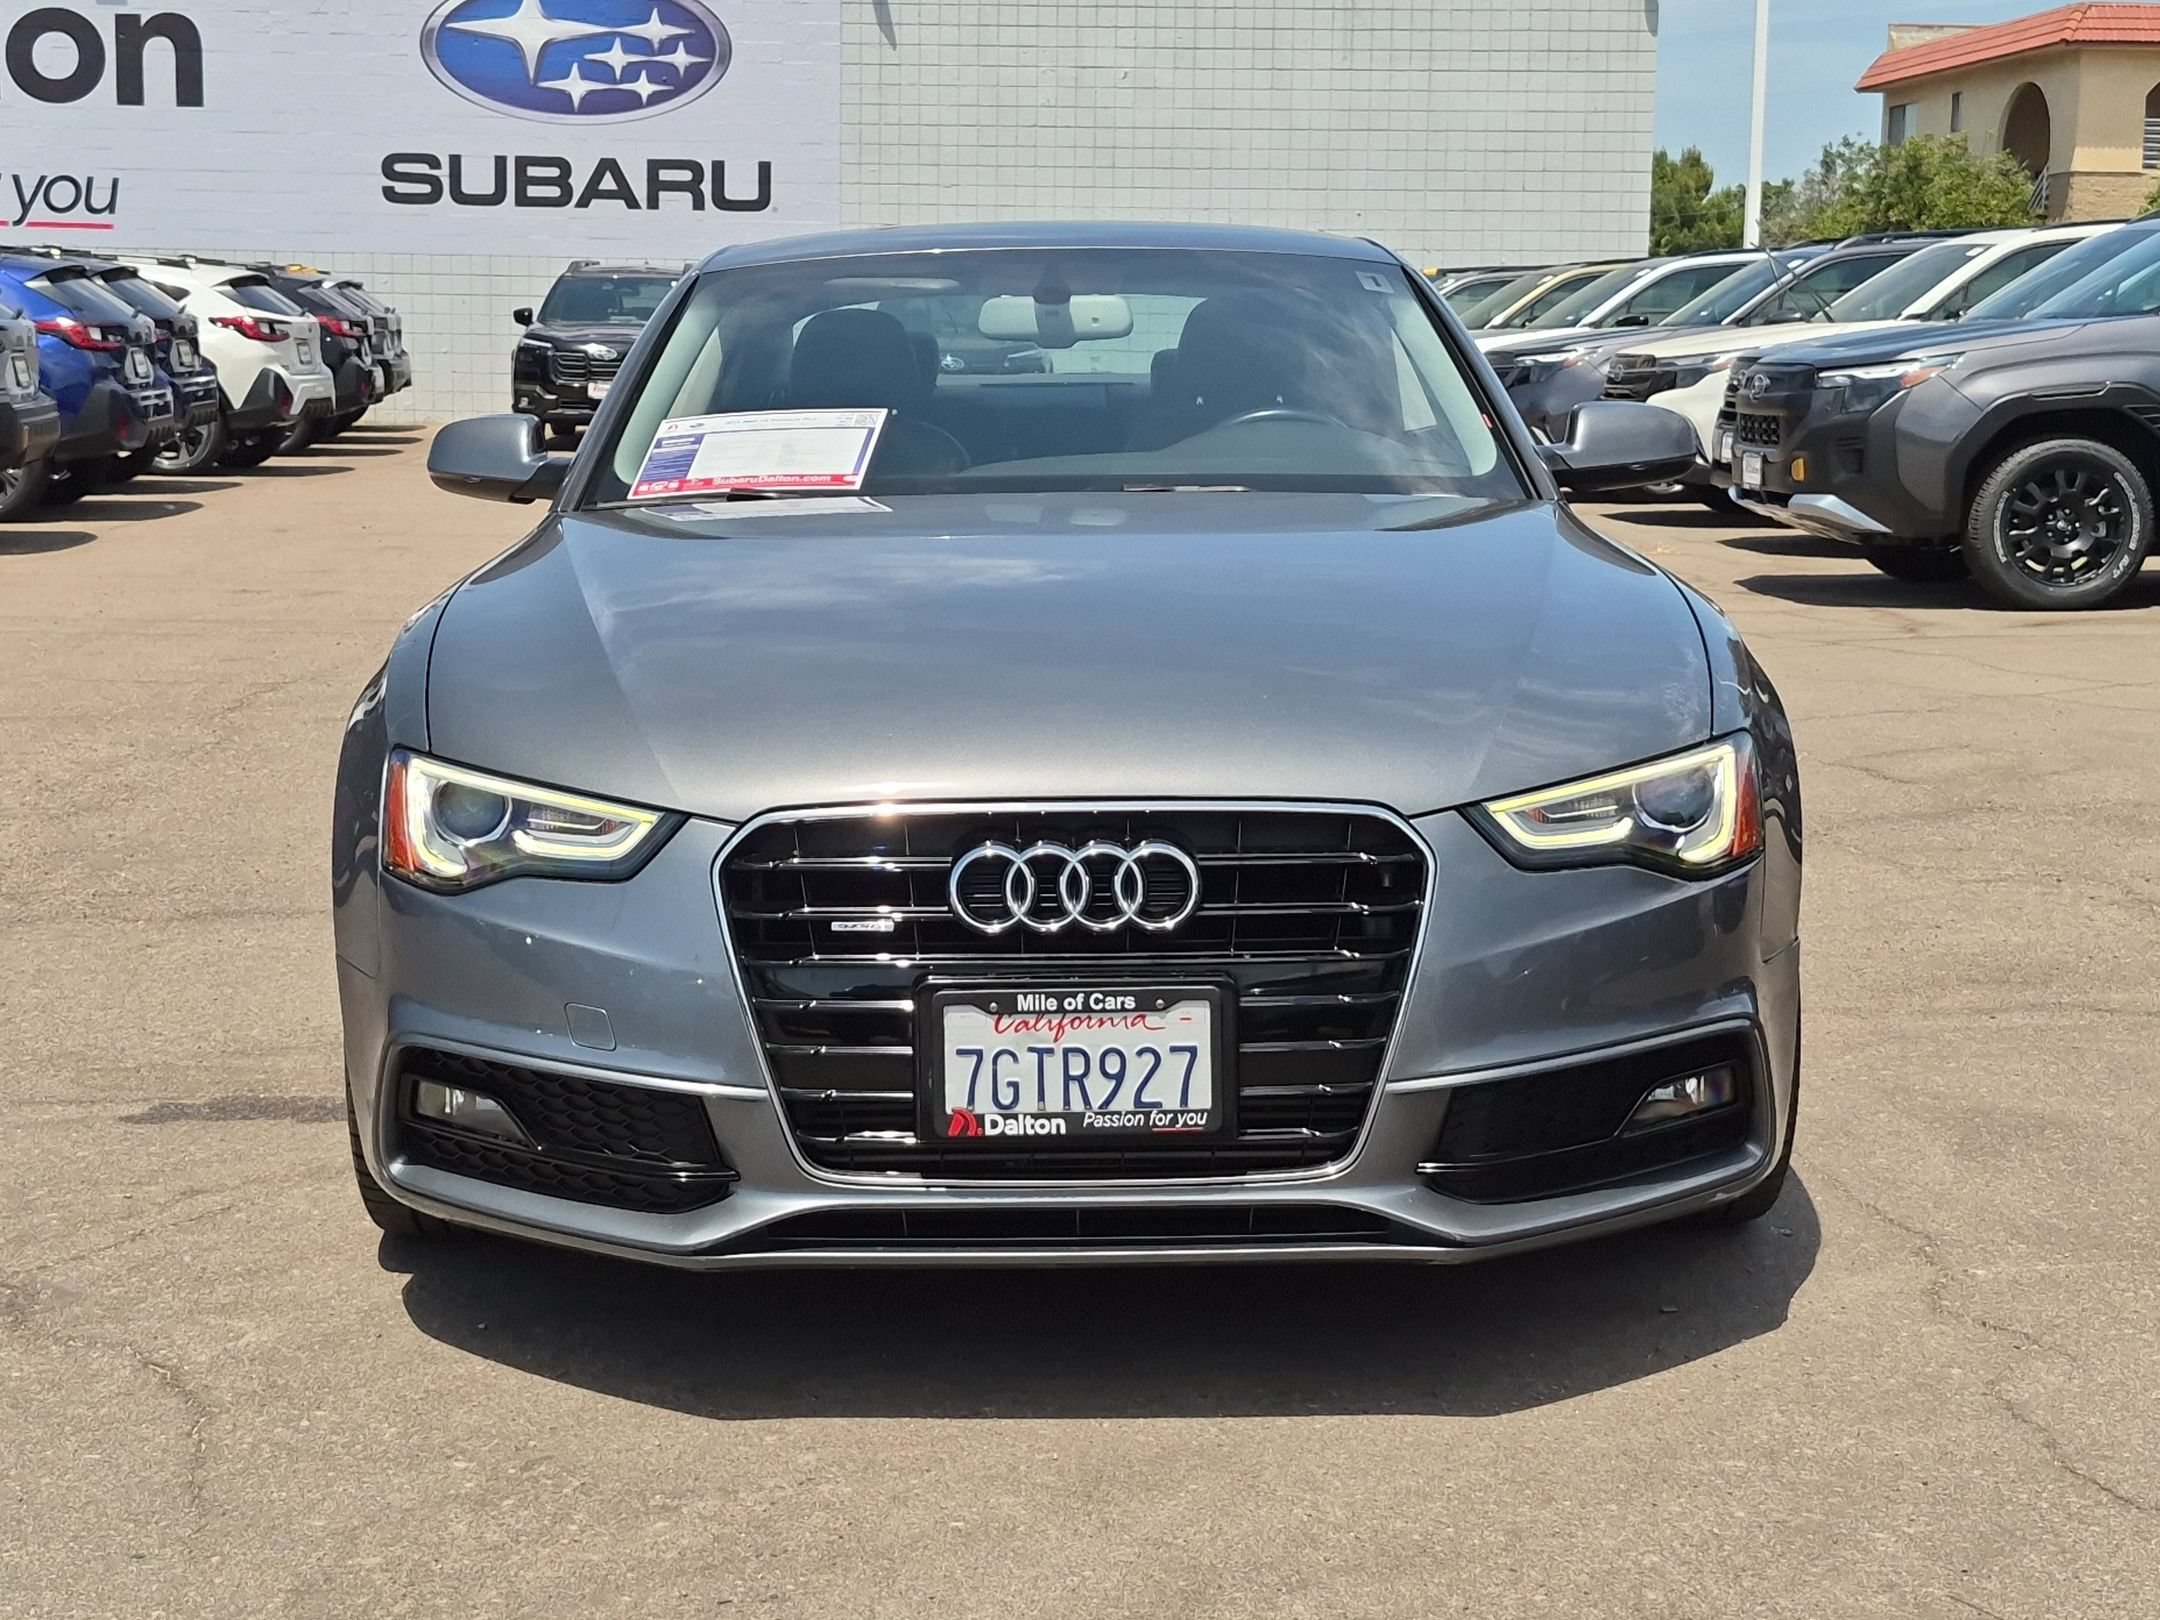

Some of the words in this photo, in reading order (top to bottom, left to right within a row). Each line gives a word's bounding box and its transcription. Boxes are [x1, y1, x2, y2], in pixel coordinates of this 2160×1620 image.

[381, 152, 772, 212] SUBARU
[11, 173, 120, 227] you
[712, 474, 831, 486] SubaruDalton.com
[1016, 994, 1057, 1012] Mile
[1063, 993, 1086, 1011] of
[1089, 992, 1136, 1010] Cars
[993, 1012, 1166, 1043] California
[955, 1044, 1199, 1111] 7GTR927
[984, 1113, 1067, 1136] Dalton
[1082, 1112, 1145, 1128] Passion
[1149, 1110, 1174, 1127] for
[1174, 1112, 1208, 1129] you
